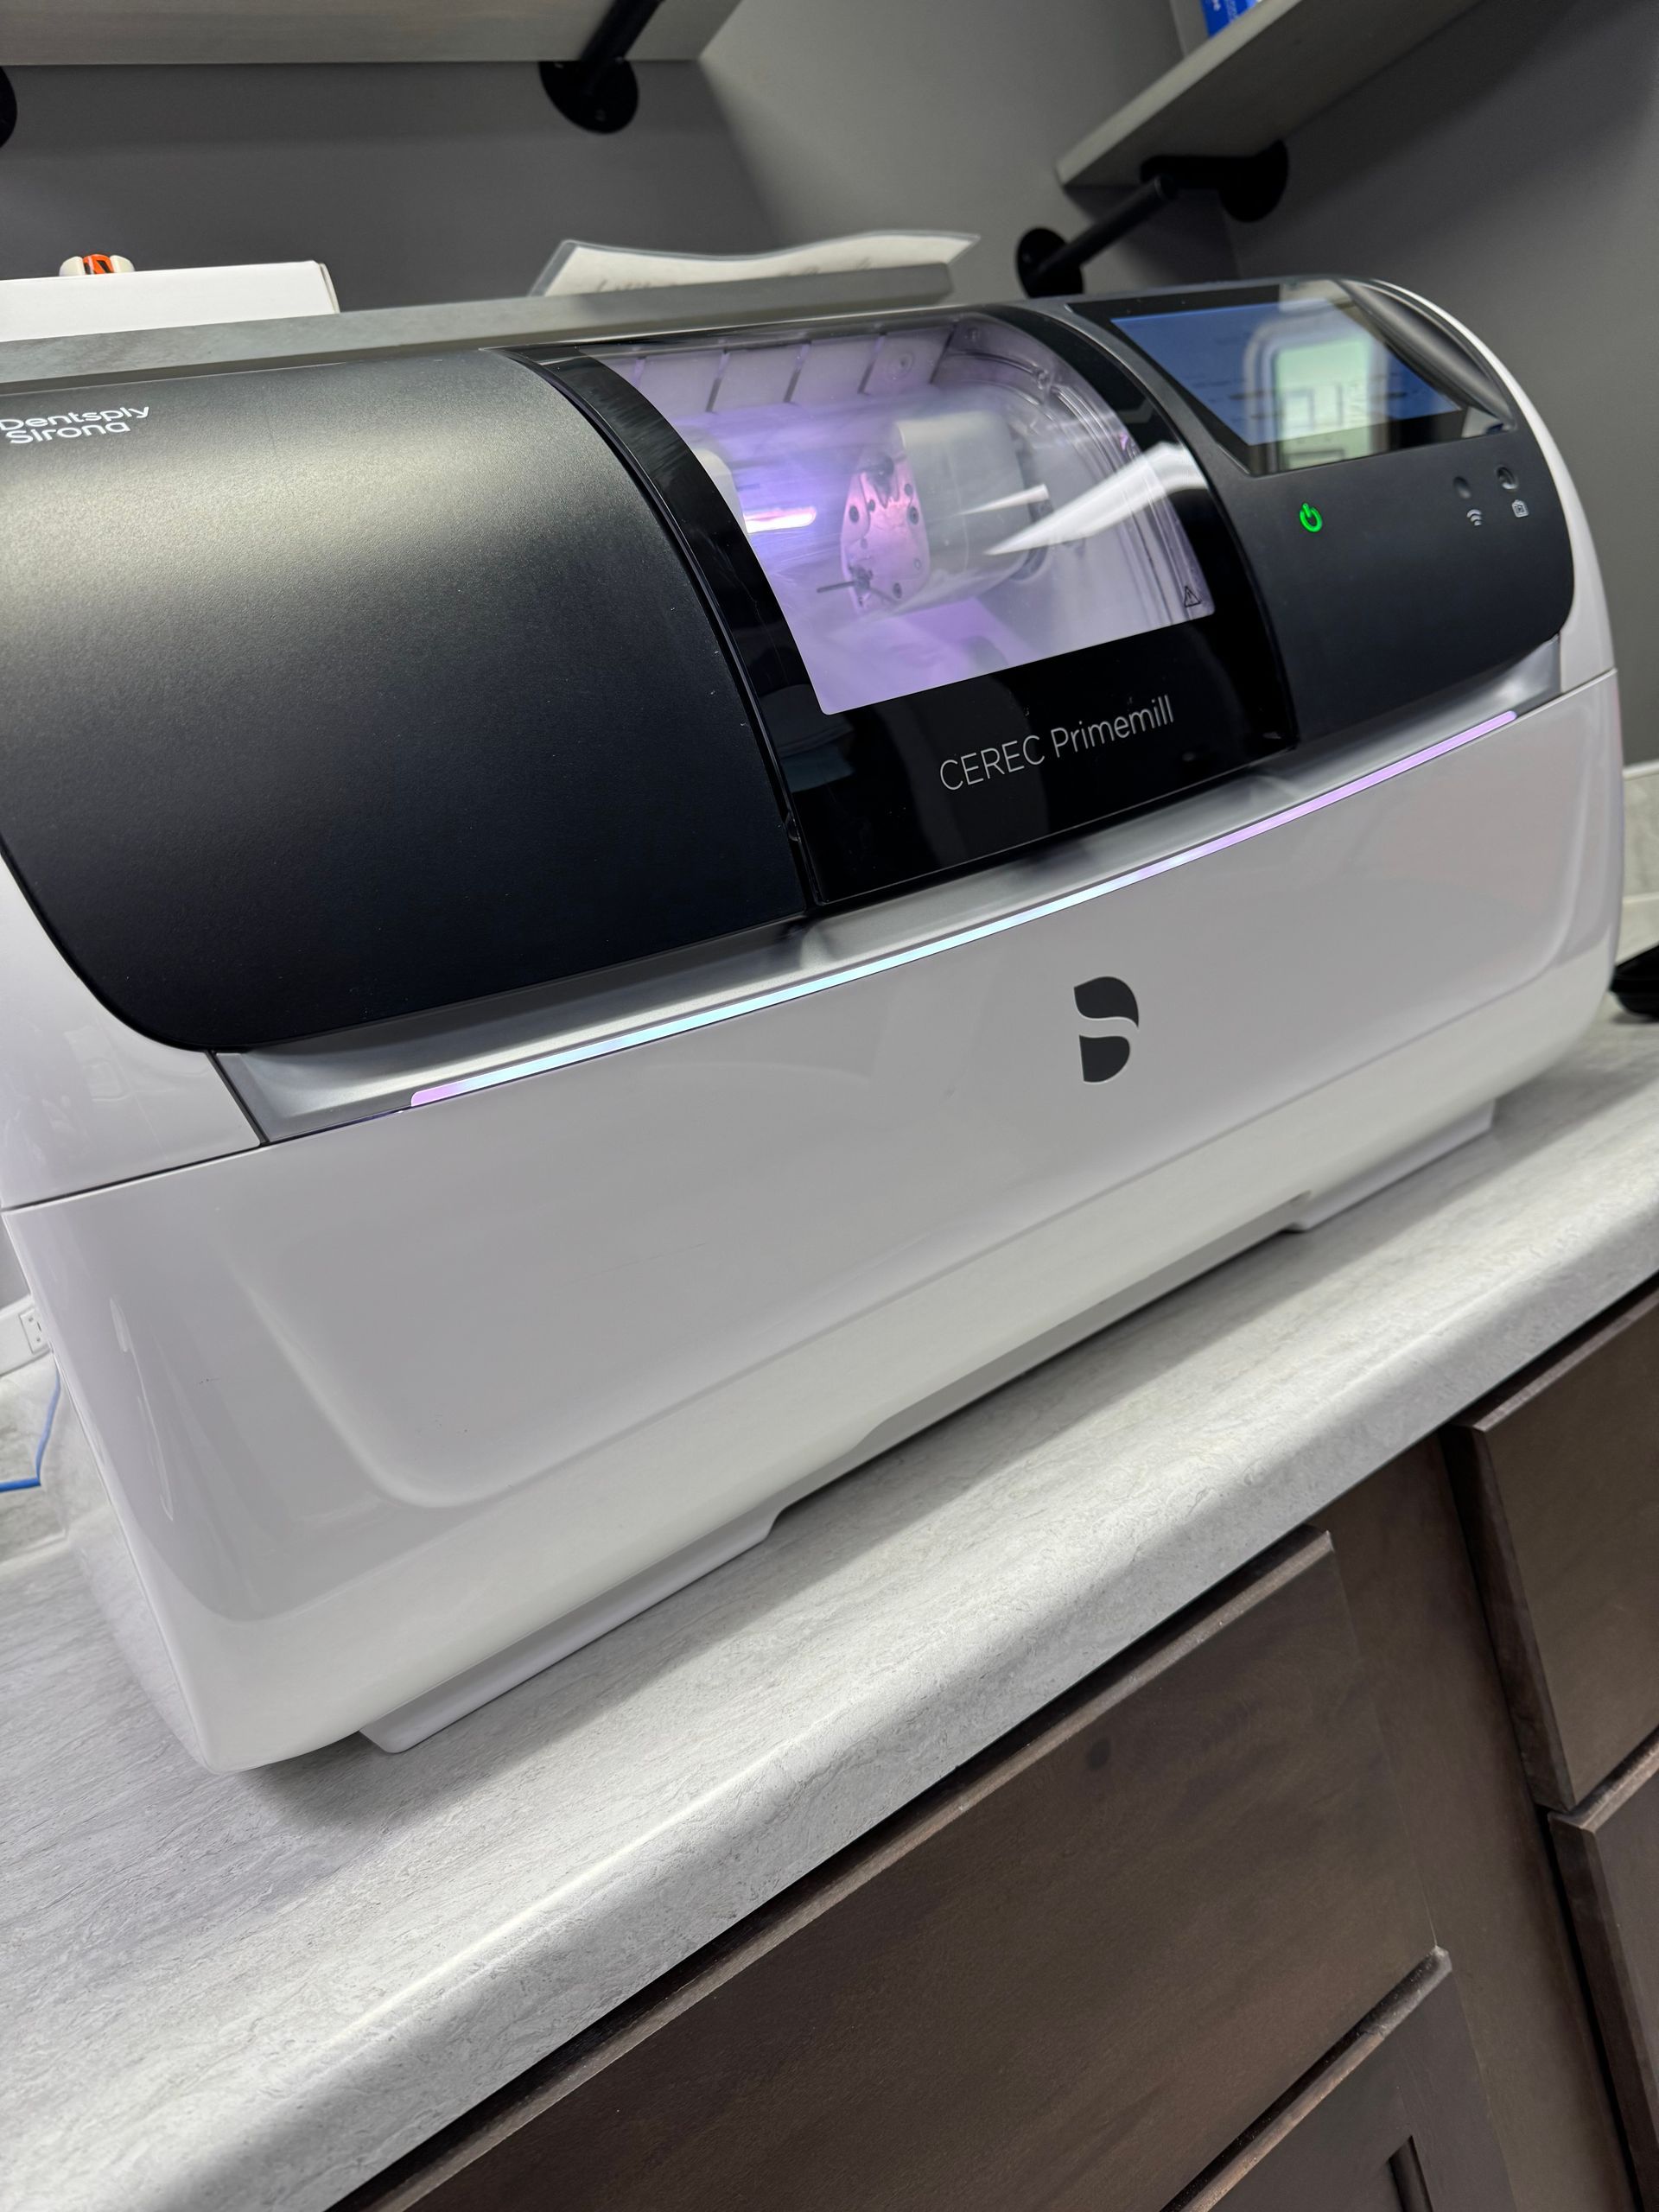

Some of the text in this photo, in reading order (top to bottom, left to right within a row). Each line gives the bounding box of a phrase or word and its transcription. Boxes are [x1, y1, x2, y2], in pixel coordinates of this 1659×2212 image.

[0, 406, 149, 431] Dentsply
[5, 422, 131, 444] Sirona
[940, 695, 1174, 790] CEREC Primemill
